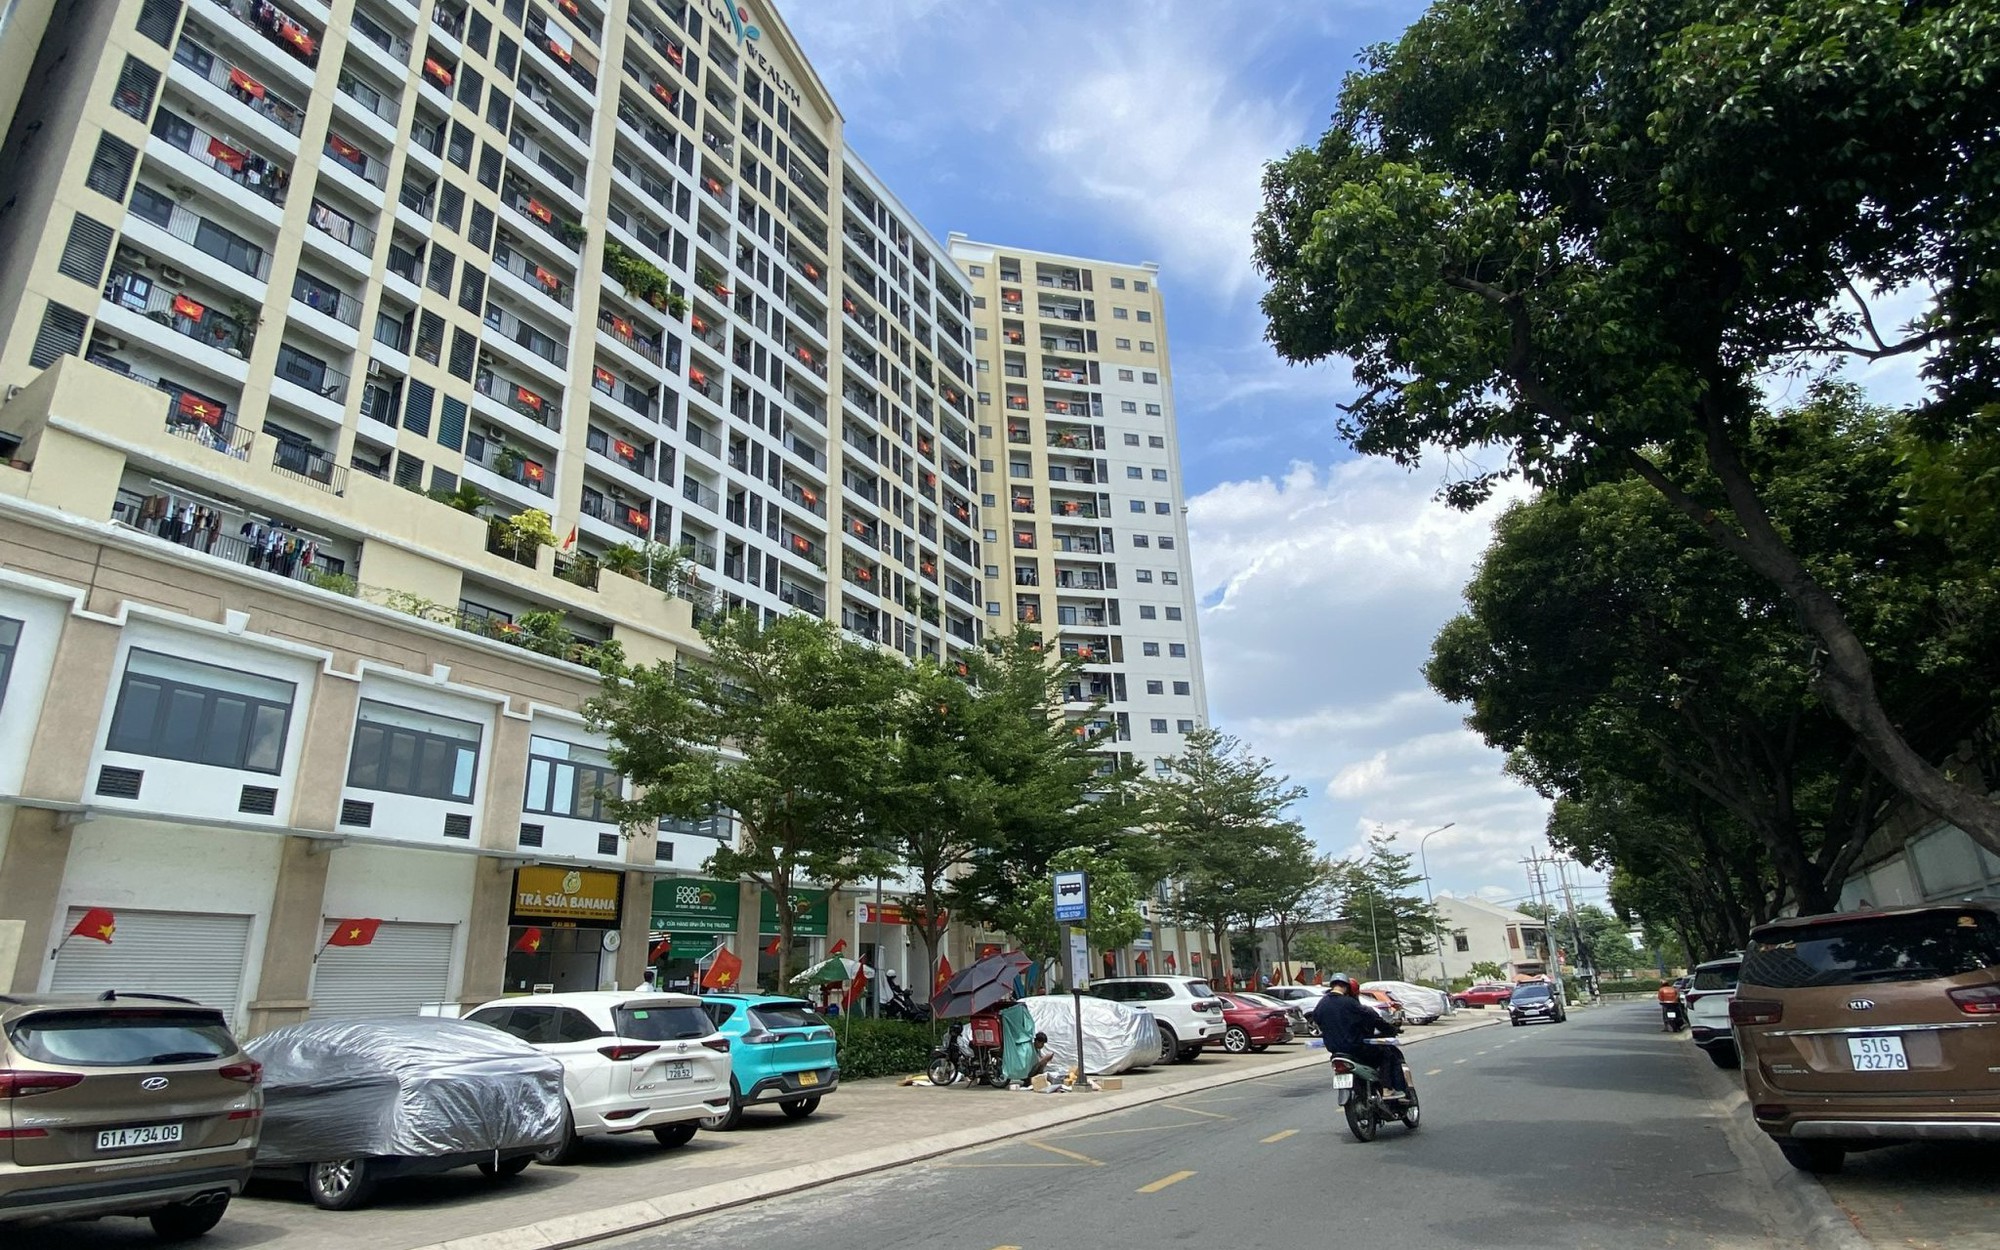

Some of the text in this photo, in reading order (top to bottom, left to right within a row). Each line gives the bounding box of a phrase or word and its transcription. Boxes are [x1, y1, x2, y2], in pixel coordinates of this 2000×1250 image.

[745, 39, 801, 108] WEALTH
[676, 885, 700, 895] COOP
[519, 889, 616, 910] TRÀ SỮA BANANA
[675, 894, 700, 904] FOOD
[1850, 1001, 1871, 1009] KIA
[1860, 1038, 1890, 1053] 51G
